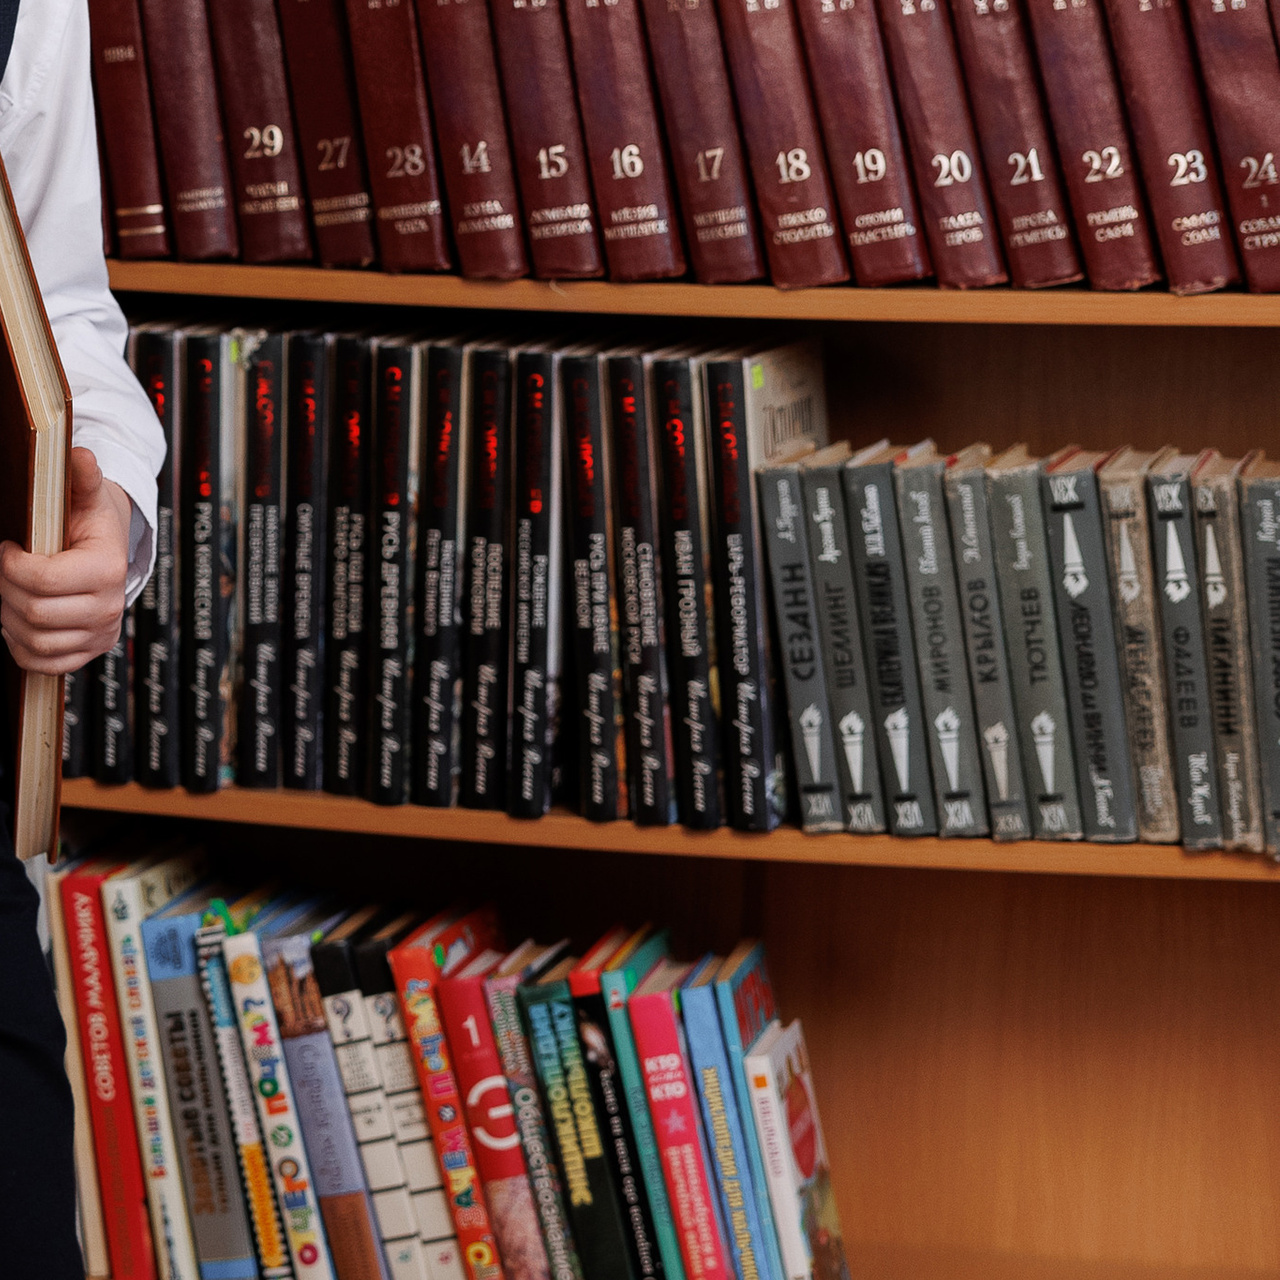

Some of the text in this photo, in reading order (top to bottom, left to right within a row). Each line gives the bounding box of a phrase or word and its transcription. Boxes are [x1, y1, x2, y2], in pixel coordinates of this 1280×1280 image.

[244, 125, 284, 160] 29
[317, 137, 351, 171] 27
[460, 141, 492, 175] 14
[386, 144, 425, 180] 28
[536, 145, 569, 180] 15
[610, 145, 644, 179] 16
[695, 148, 725, 182] 17
[776, 148, 811, 185] 18
[852, 148, 887, 185] 19
[931, 150, 973, 187] 20
[1008, 150, 1045, 187] 21
[1082, 146, 1124, 185] 22
[1168, 150, 1207, 187] 23
[1240, 153, 1278, 189] 24
[193, 502, 212, 542] РУСЬ
[380, 511, 400, 559] РУСЬ
[674, 530, 702, 658] ИВАН ГРОЗНЫЙ
[780, 562, 817, 683] СЕЗАНН
[822, 580, 859, 691] ШЕЛЛИНГ
[926, 584, 955, 695] МИРОНОВ
[965, 577, 1001, 685] КРЫЛОВ
[1019, 586, 1051, 688] ТЮТЧЕВ
[1171, 625, 1200, 731] ФАДЕЕВ
[70, 889, 118, 1103] СОВЕТОВ МАЛЬЧИКУ
[642, 1051, 683, 1075] КТО
[649, 1078, 689, 1102] КТО
